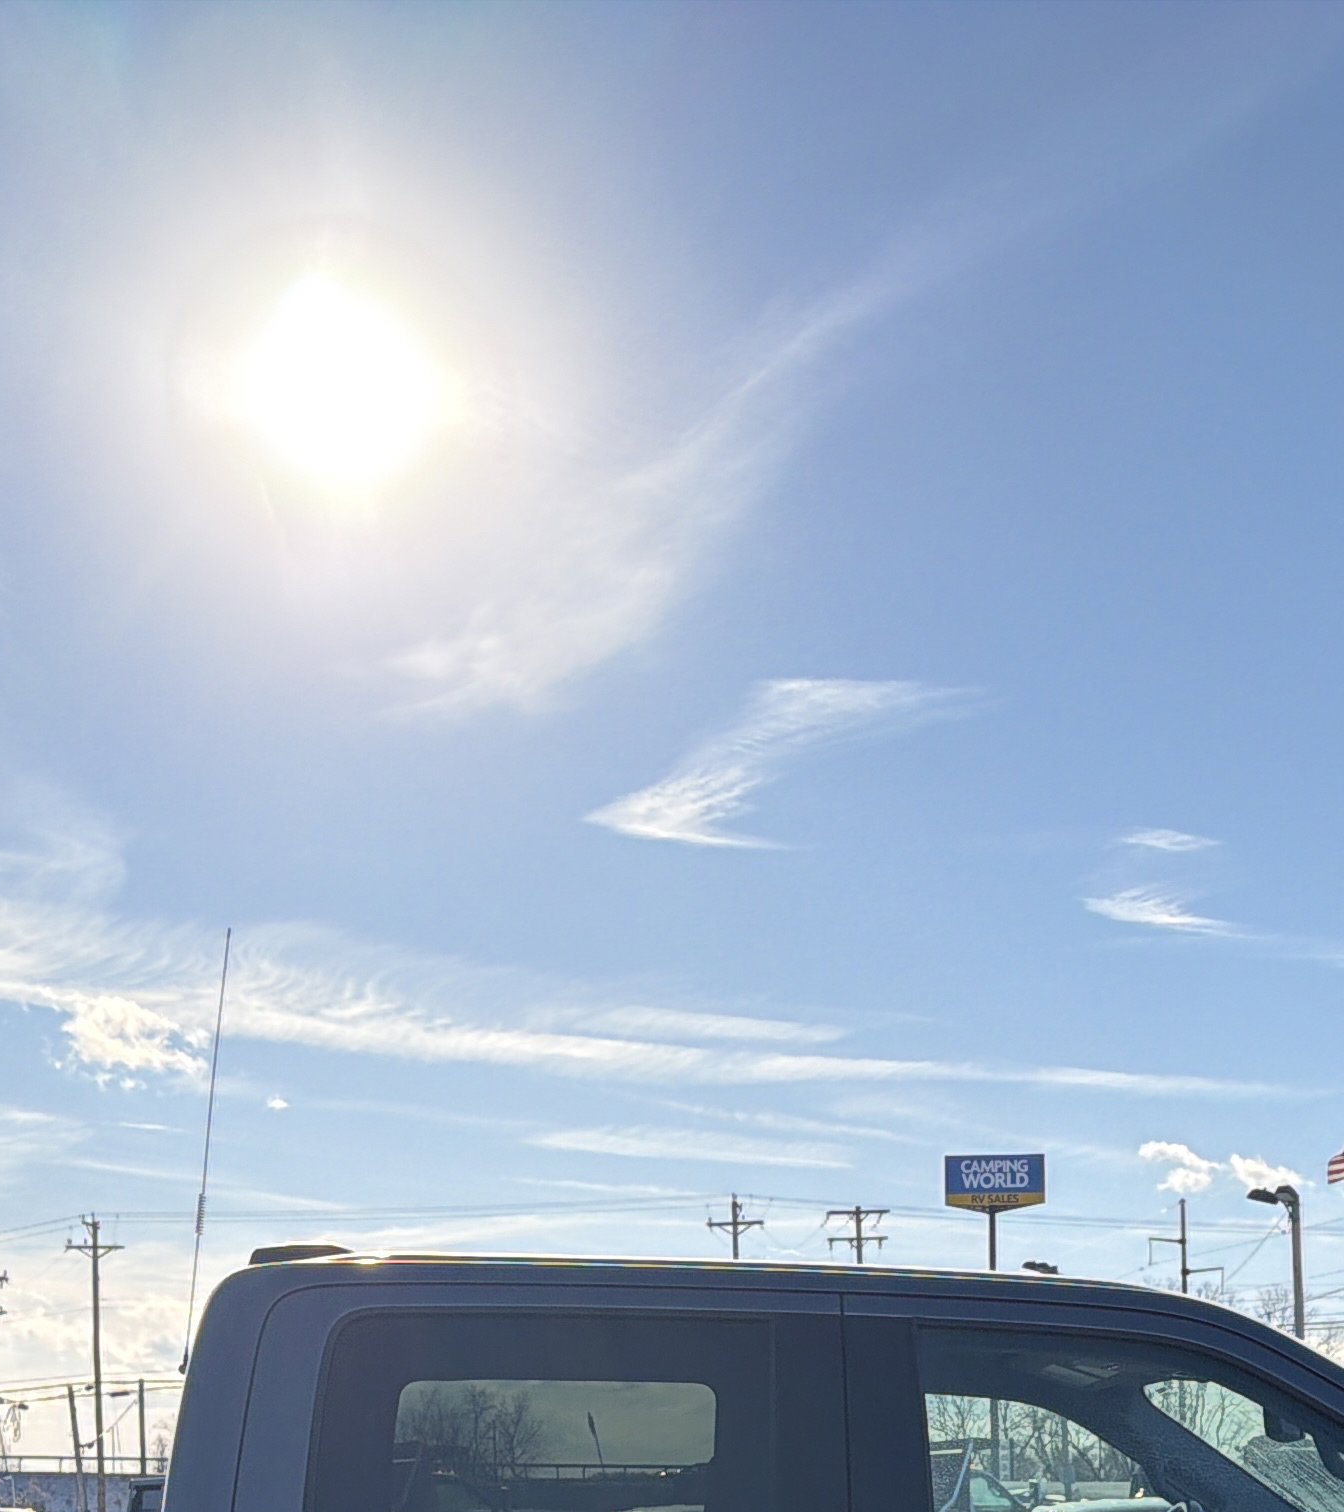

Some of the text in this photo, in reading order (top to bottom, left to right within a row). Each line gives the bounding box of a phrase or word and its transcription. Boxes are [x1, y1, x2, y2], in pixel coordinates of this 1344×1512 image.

[960, 1159, 1029, 1174] CAMPING
[961, 1172, 1030, 1189] WORLD
[971, 1194, 1020, 1204] RV SALES
